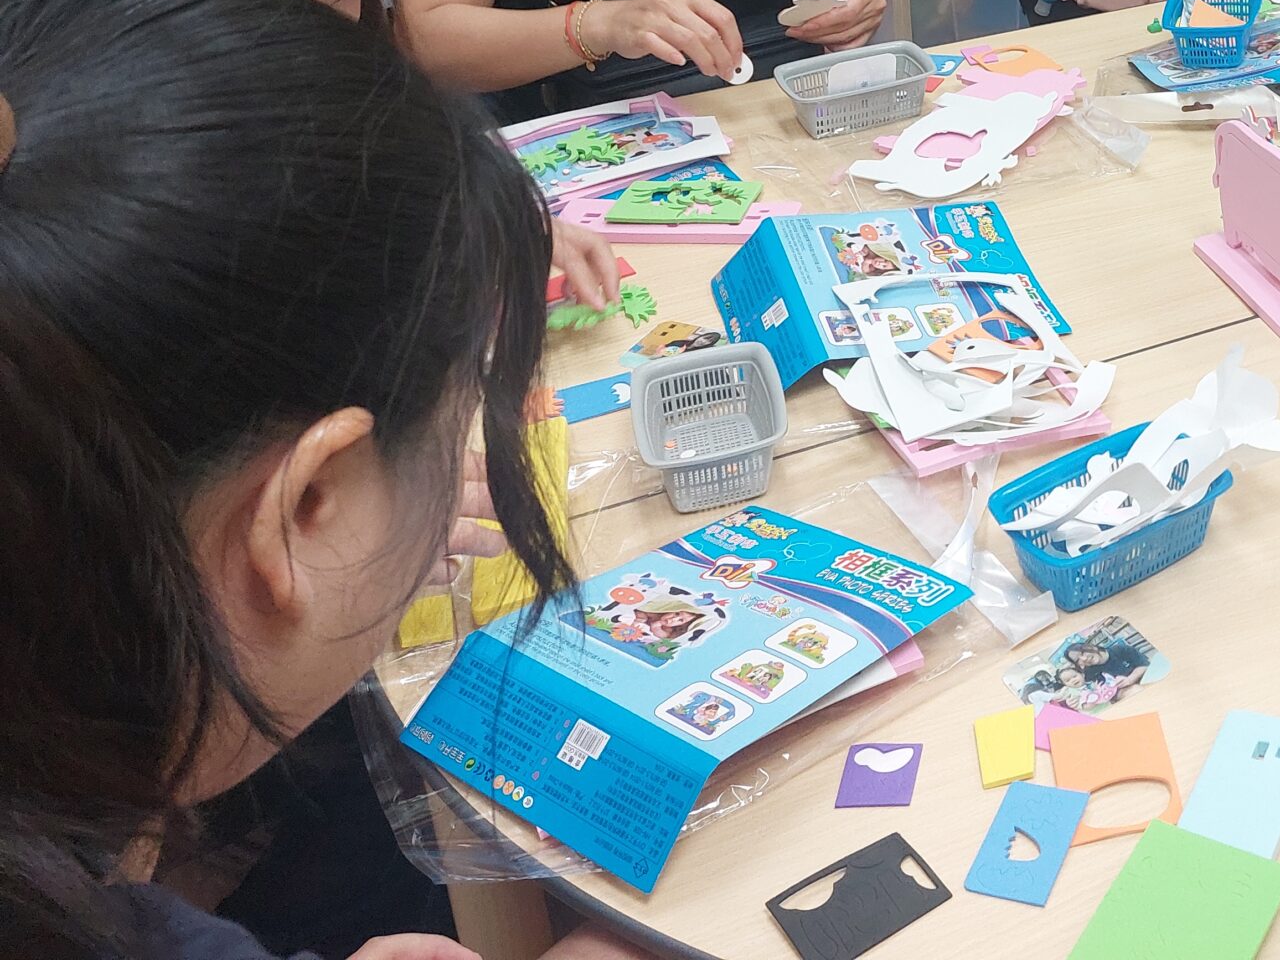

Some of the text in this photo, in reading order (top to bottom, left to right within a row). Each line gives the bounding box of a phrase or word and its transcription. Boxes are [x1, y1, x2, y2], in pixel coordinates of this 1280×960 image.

[815, 568, 915, 613] EVA PHOTO SERIES
[833, 548, 955, 607] 相框系列
